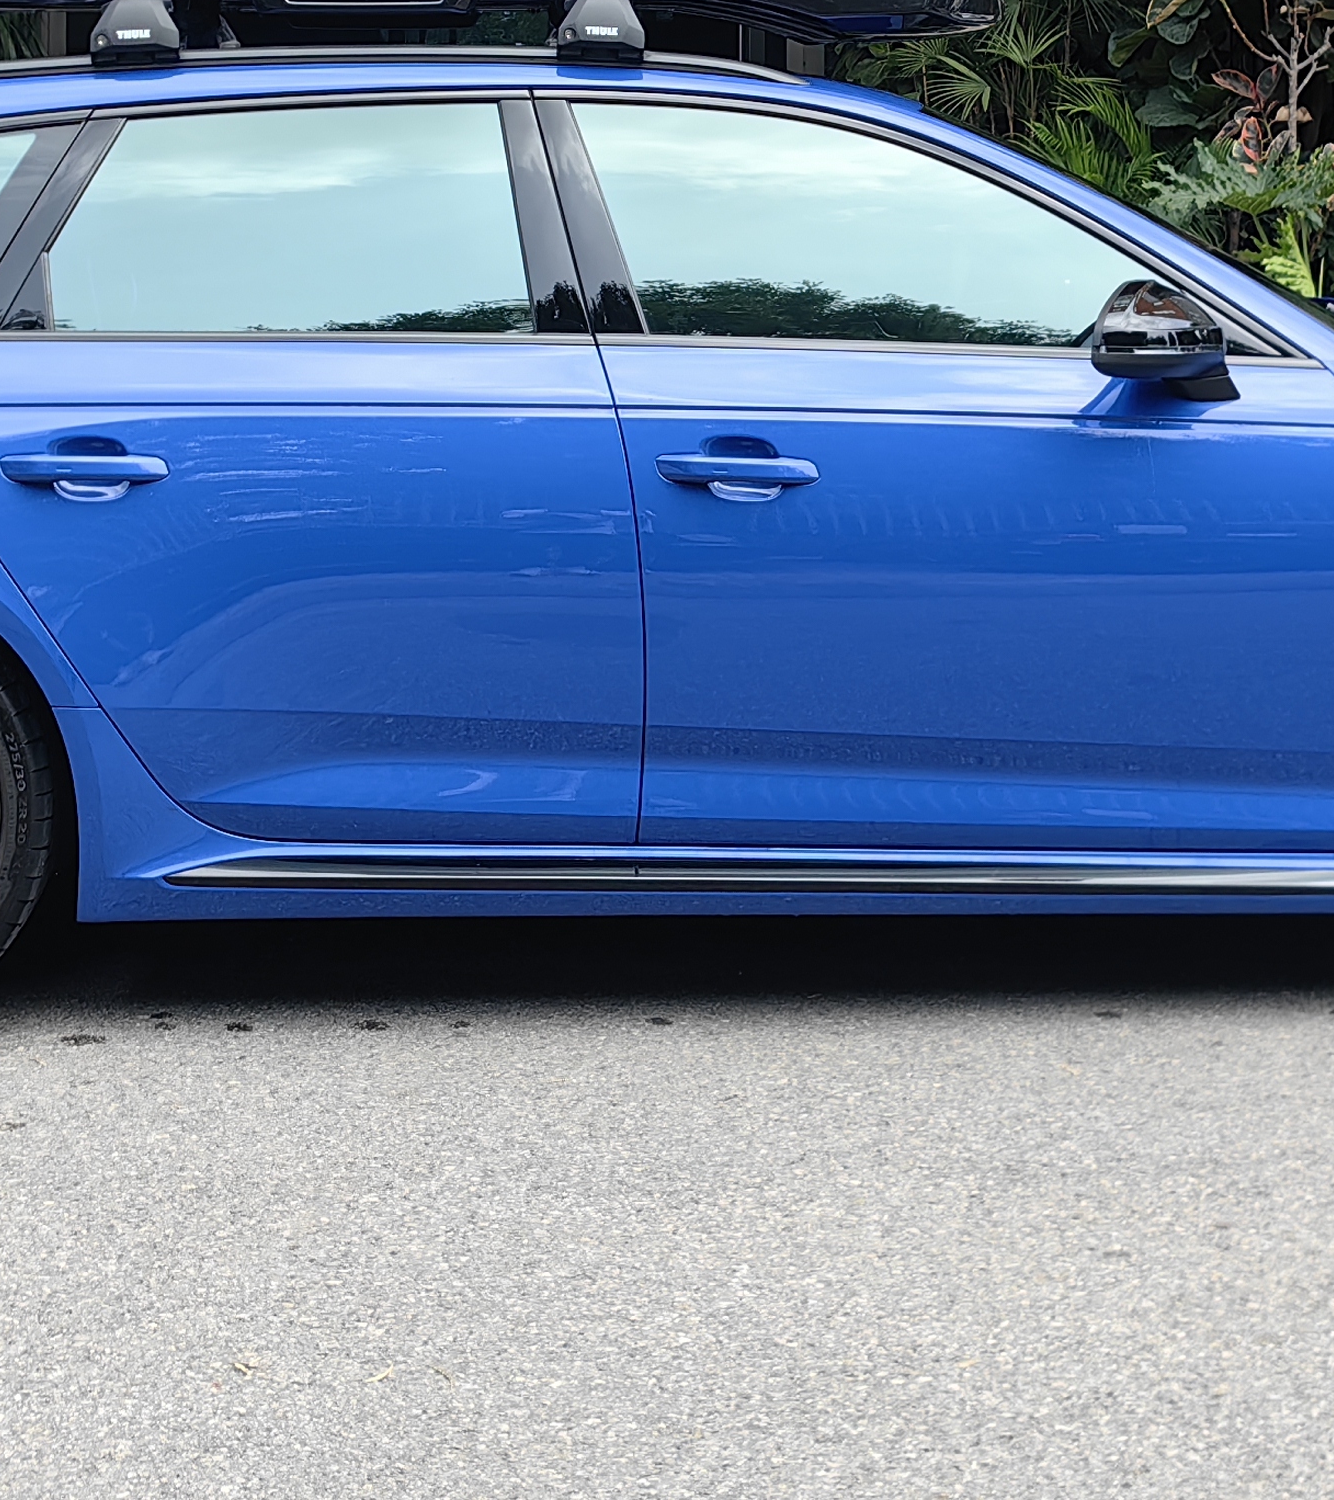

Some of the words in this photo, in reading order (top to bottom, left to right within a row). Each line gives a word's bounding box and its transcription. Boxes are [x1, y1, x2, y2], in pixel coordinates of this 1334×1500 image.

[116, 29, 151, 39] THULE
[585, 26, 619, 36] THULE
[4, 731, 27, 792] 275/30
[17, 823, 28, 845] 20
